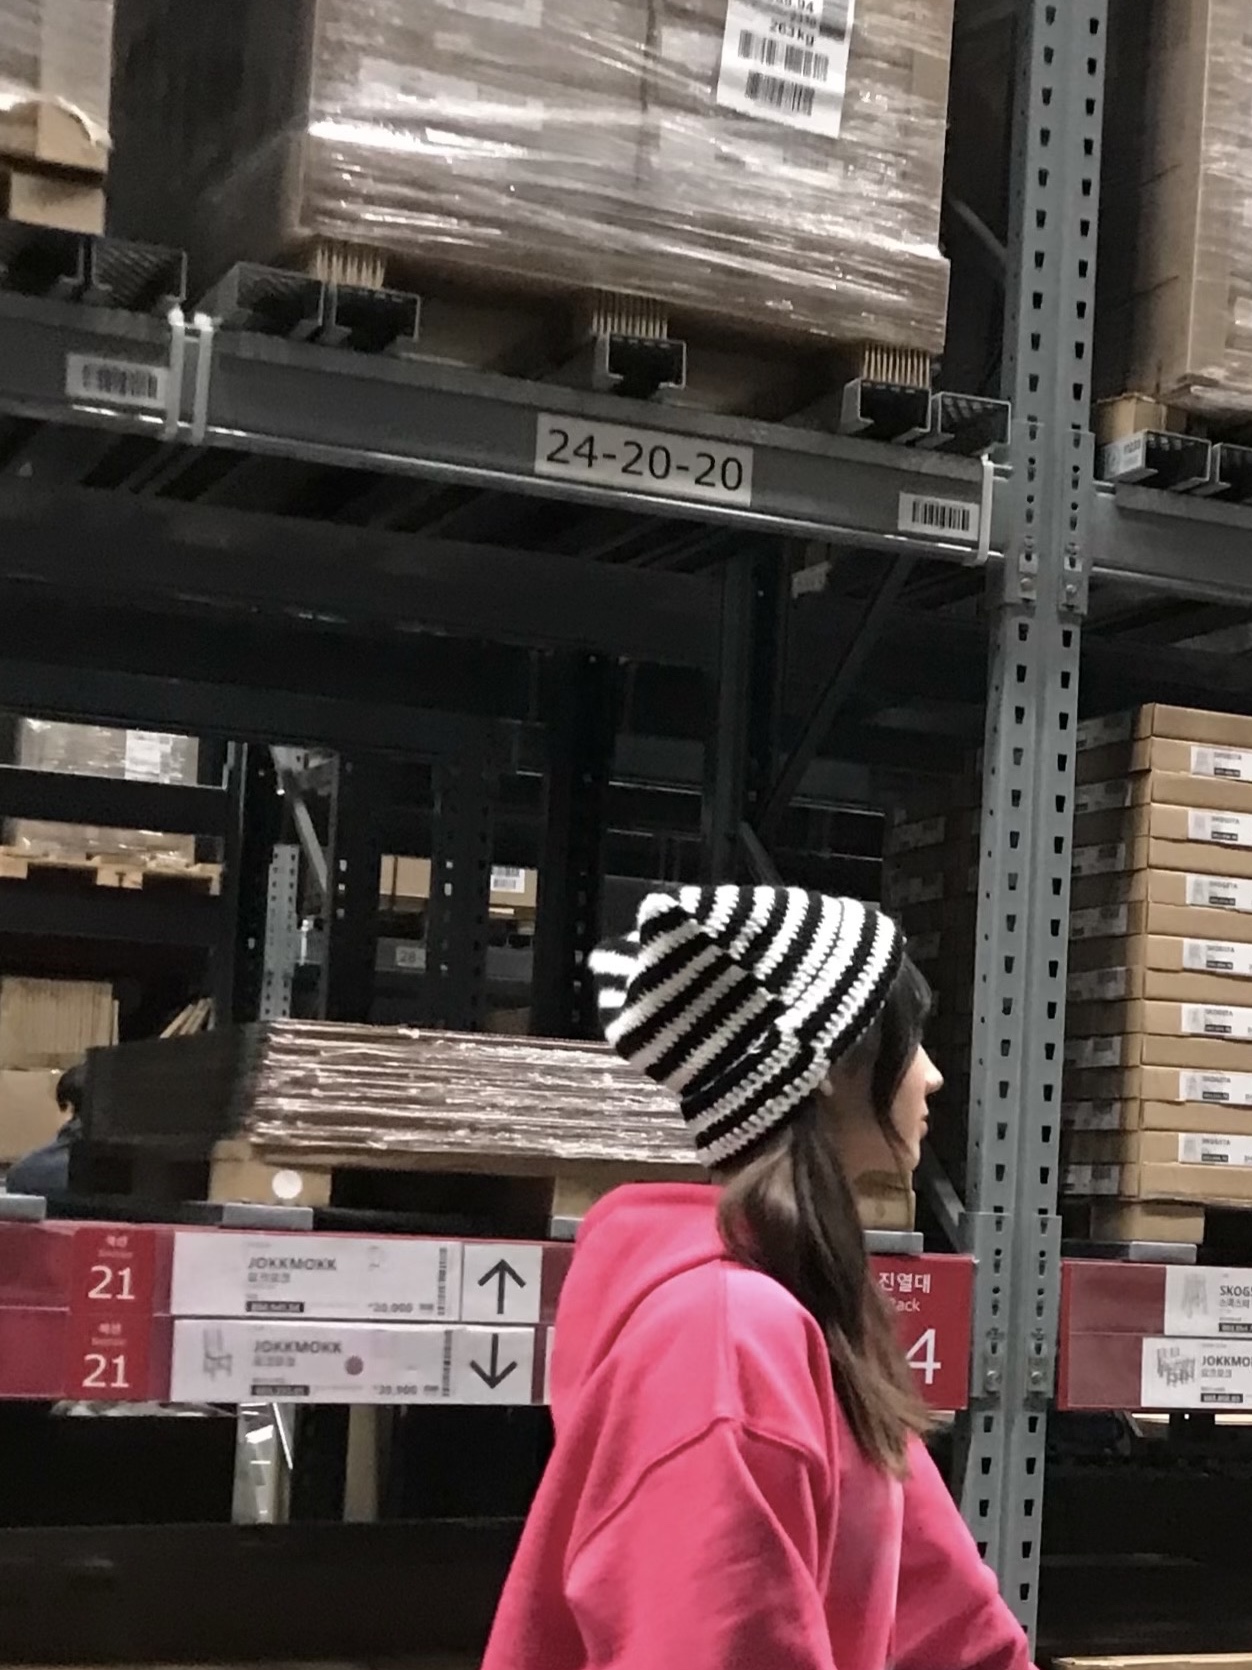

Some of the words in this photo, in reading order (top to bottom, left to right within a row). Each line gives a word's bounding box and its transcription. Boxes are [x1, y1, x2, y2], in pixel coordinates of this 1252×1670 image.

[547, 429, 743, 491] 24-20-20
[248, 1257, 337, 1271] JOKKMOKK
[87, 1265, 136, 1300] 21
[878, 1272, 932, 1294] 진열대
[254, 1341, 343, 1354] JOKKMOKK
[905, 1328, 941, 1384] 4
[82, 1353, 130, 1389] 21
